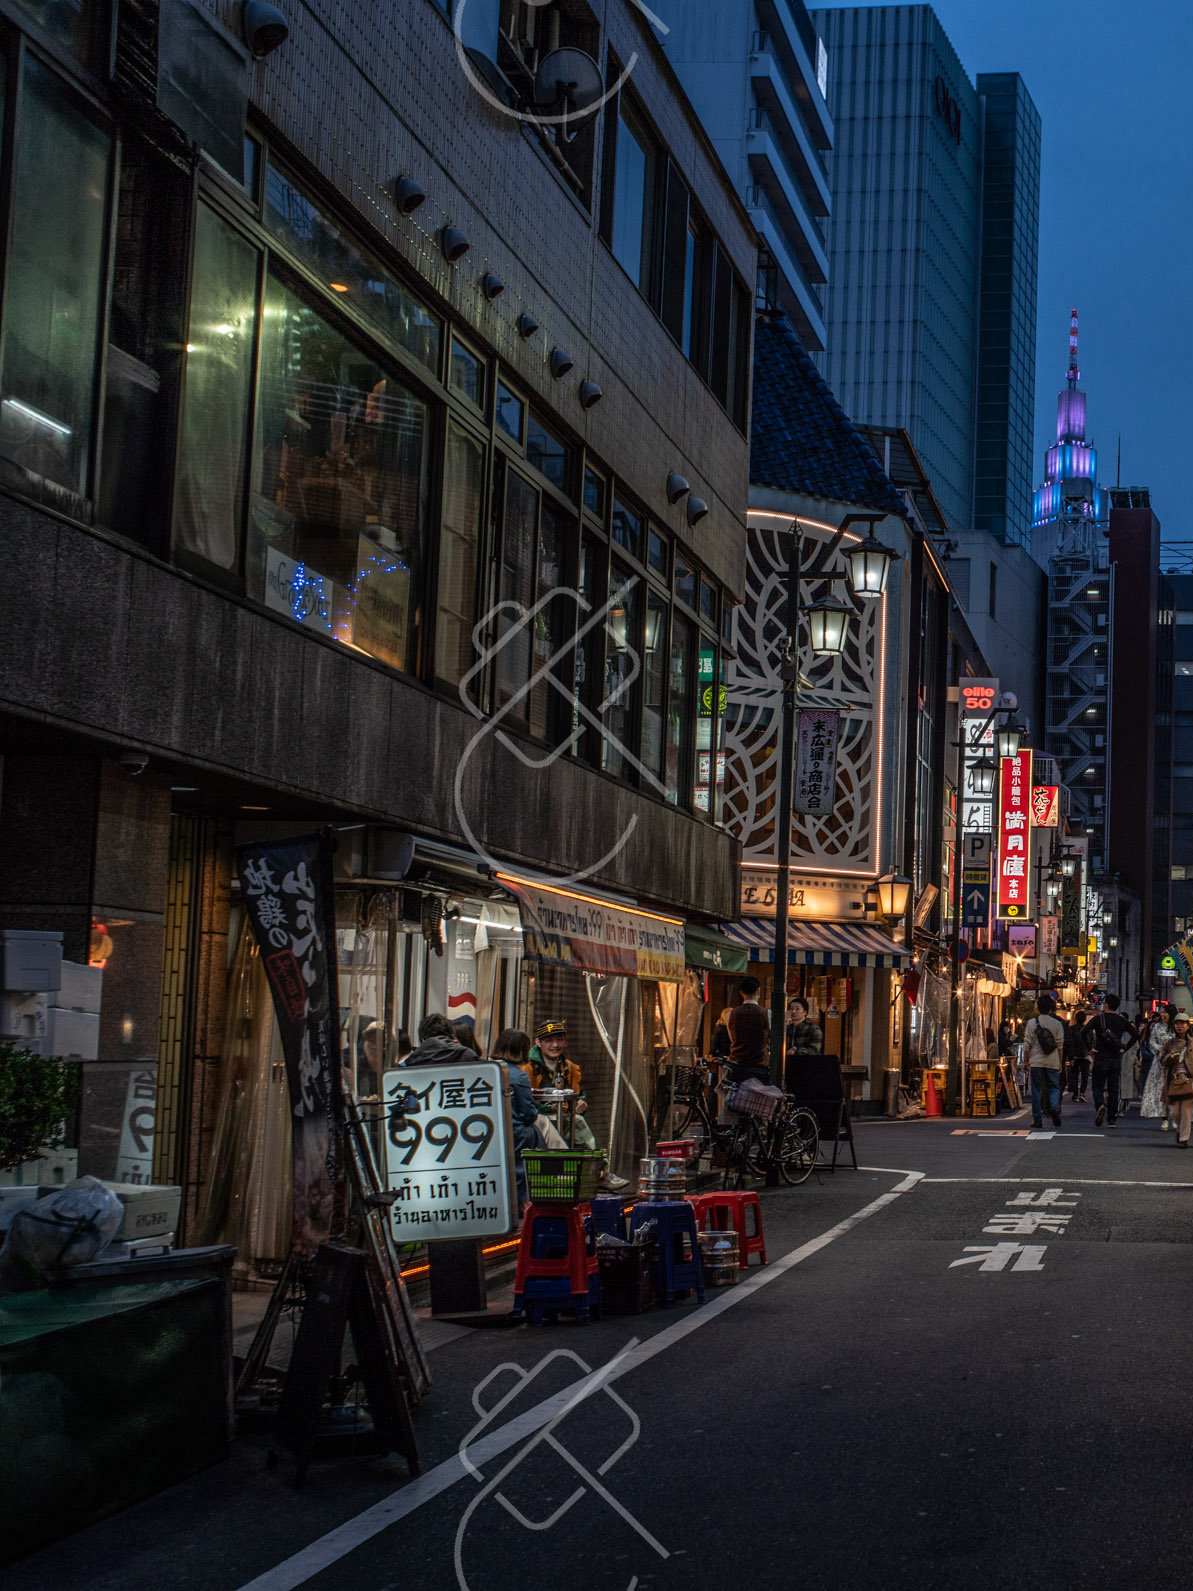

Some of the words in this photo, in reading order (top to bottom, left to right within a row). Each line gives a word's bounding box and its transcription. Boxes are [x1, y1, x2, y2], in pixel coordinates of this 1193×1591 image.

[962, 687, 995, 698] elite
[965, 698, 992, 709] 50
[807, 718, 827, 809] 末広通り商店会
[1033, 787, 1049, 825] 花ぜん
[971, 838, 984, 857] P
[1009, 879, 1018, 899] 本店
[547, 1023, 554, 1032] P
[388, 1113, 495, 1166] 999
[430, 1175, 458, 1199] เก้า
[468, 1172, 497, 1196] เก้า
[393, 1200, 498, 1225] ร้านอาหารไทย
[948, 1188, 1082, 1272] 止まれ
